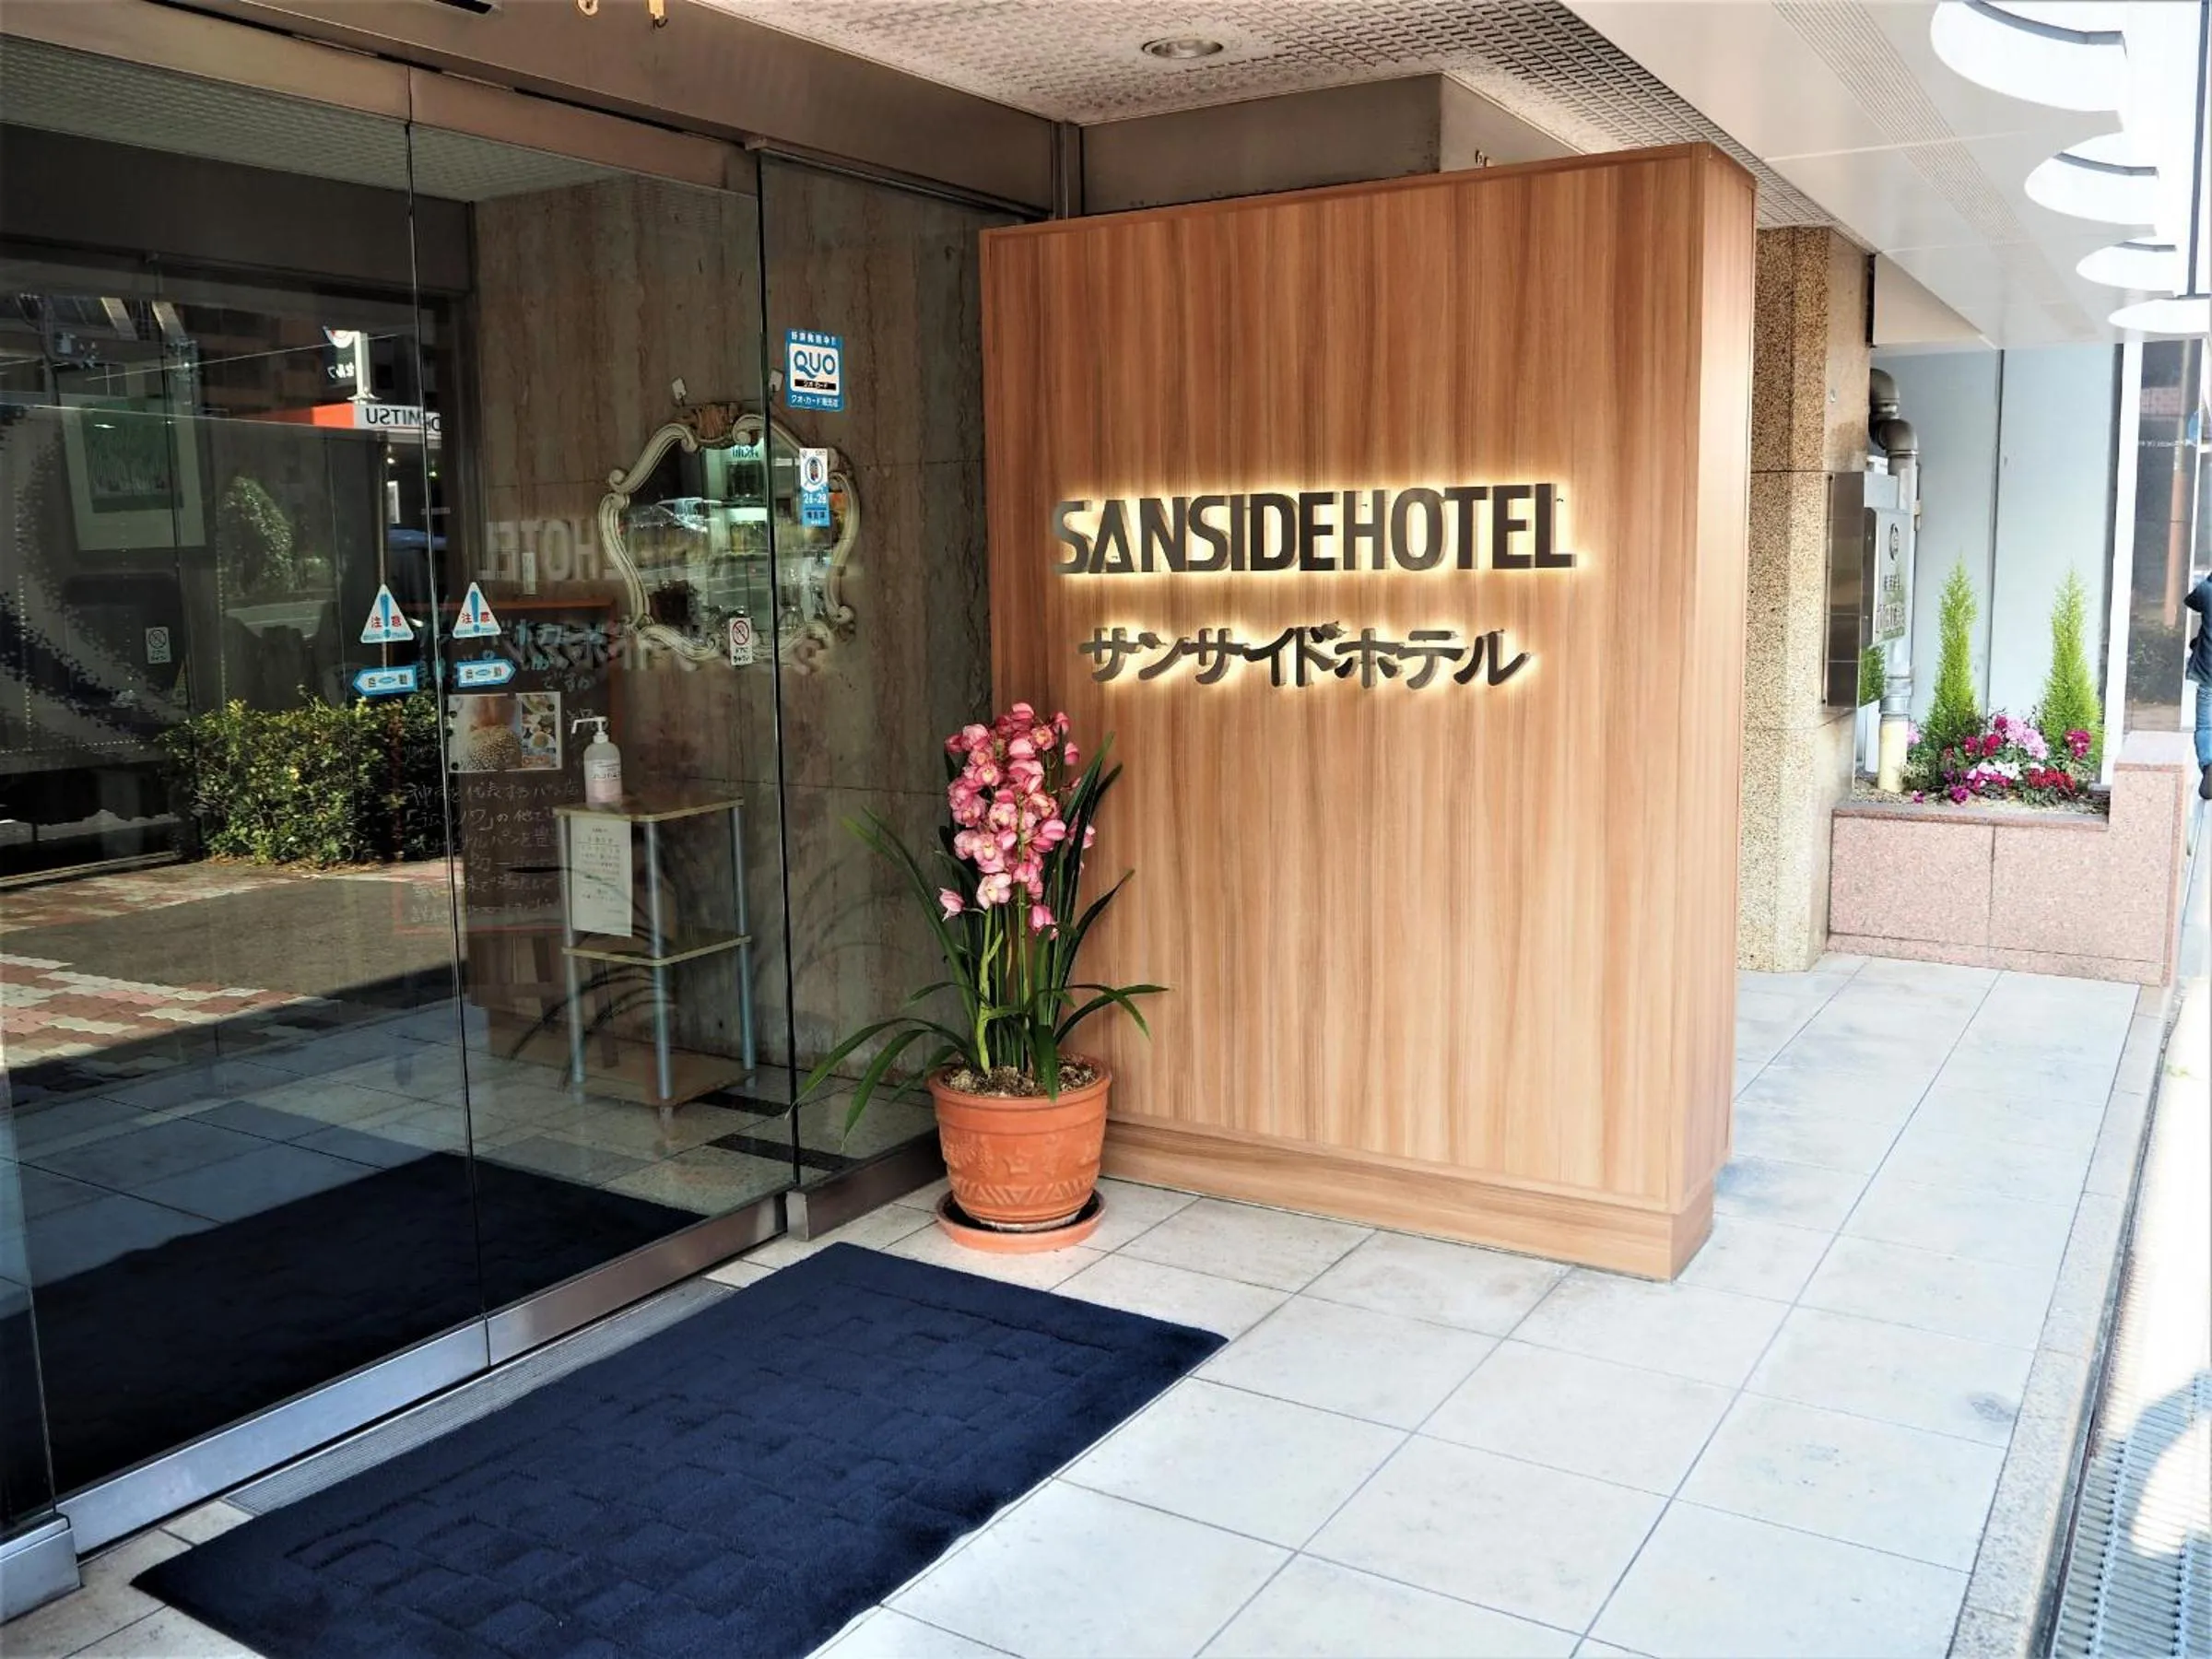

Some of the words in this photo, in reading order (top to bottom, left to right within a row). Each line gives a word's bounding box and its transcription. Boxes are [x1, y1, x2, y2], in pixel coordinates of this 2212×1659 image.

[794, 350, 836, 379] QUO
[1052, 482, 1577, 574] SANSIDEHOTEL
[371, 615, 402, 629] 注意
[462, 611, 490, 625] 注意
[1077, 620, 1532, 689] サンサイドホテル
